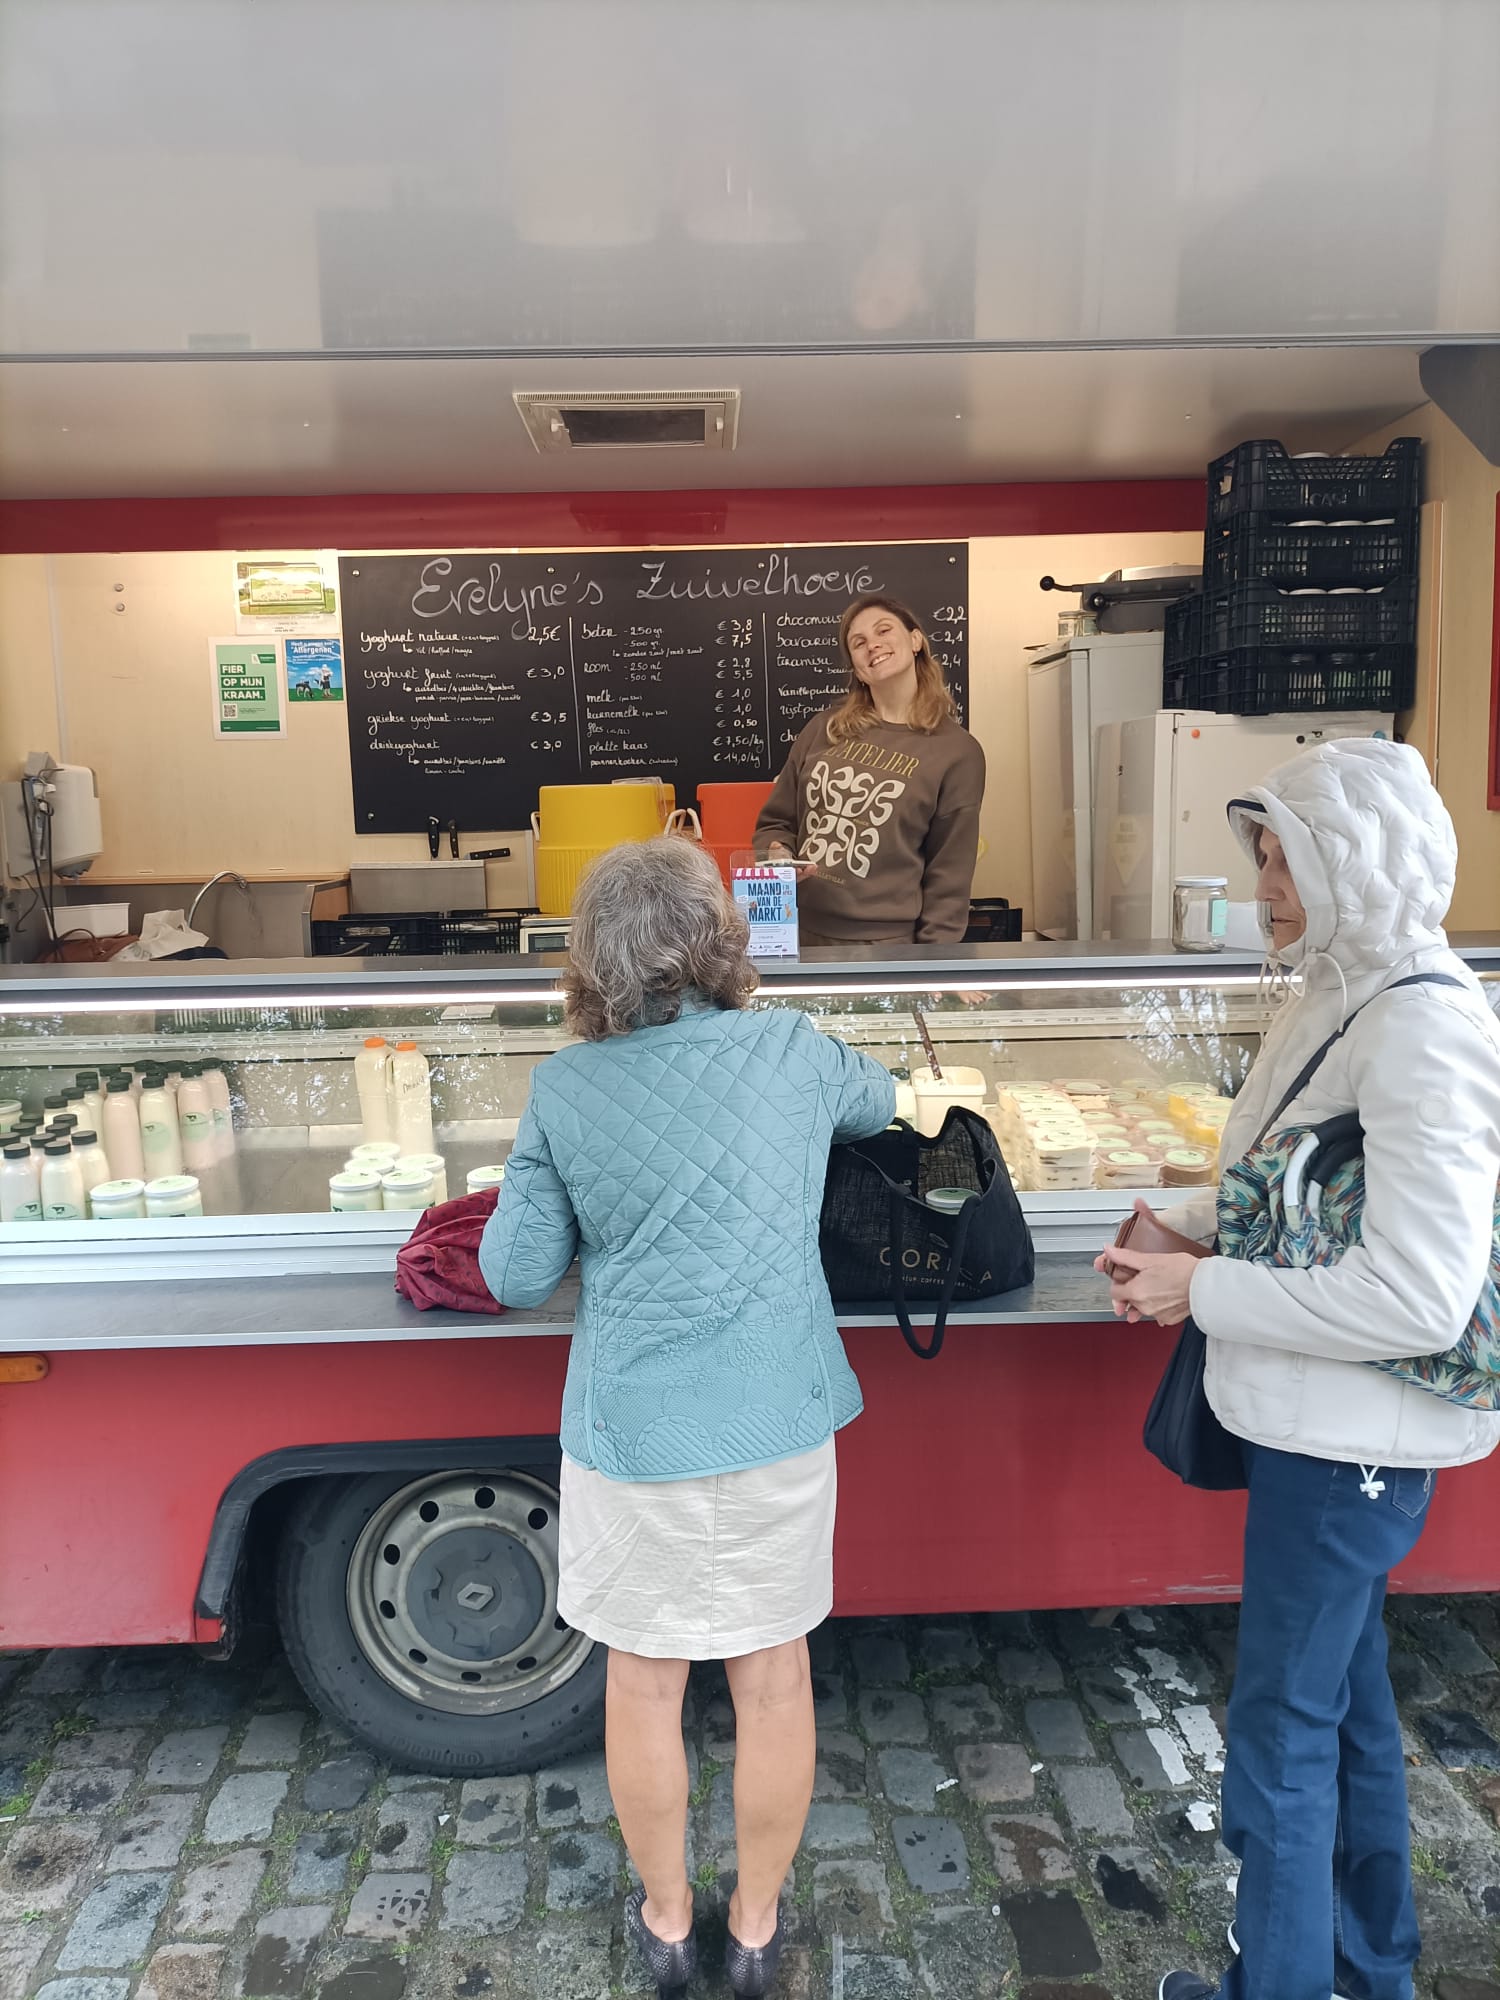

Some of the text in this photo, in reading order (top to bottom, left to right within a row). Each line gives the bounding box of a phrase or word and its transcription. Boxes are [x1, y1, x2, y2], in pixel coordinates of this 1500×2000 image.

[411, 553, 886, 641] Evelyne's Zuivelhoeve
[716, 618, 753, 633] € 3,8
[776, 611, 844, 627] chocomous
[418, 629, 461, 642] natuur
[528, 625, 562, 646] 2,5€
[581, 623, 618, 640] boter
[630, 626, 653, 636] 250
[629, 640, 648, 648] 500
[714, 632, 753, 649] € 7,5
[775, 631, 839, 648] bavarois
[716, 657, 751, 669] € 2,8
[776, 653, 834, 667] tiramisu
[941, 653, 962, 669] 2,4
[222, 665, 244, 674] FIER
[526, 665, 566, 680] € 3,0
[583, 662, 612, 673] room
[630, 662, 648, 671] 250
[222, 677, 263, 687] OP MIJN
[424, 668, 452, 687] fruit
[630, 673, 647, 682] 500
[716, 669, 753, 681] € 5,5
[223, 690, 264, 700] KRAAM.
[586, 689, 615, 703] melk
[715, 688, 751, 701] € 1,0
[586, 705, 640, 719] karnemelk
[714, 703, 752, 716] € 1,0
[779, 702, 832, 720] rijstpudd
[367, 710, 406, 736] griekse
[410, 712, 452, 730] yoghurt
[586, 722, 604, 738] fles
[716, 718, 758, 729] € 0,50
[780, 729, 801, 743] cho
[369, 738, 440, 756] drinkyoghurt
[543, 740, 562, 753] 3,0
[589, 740, 649, 755] platte kaas
[748, 882, 782, 897] MAAND
[757, 896, 771, 907] VAN
[773, 896, 782, 907] DE
[748, 907, 783, 922] MARKT
